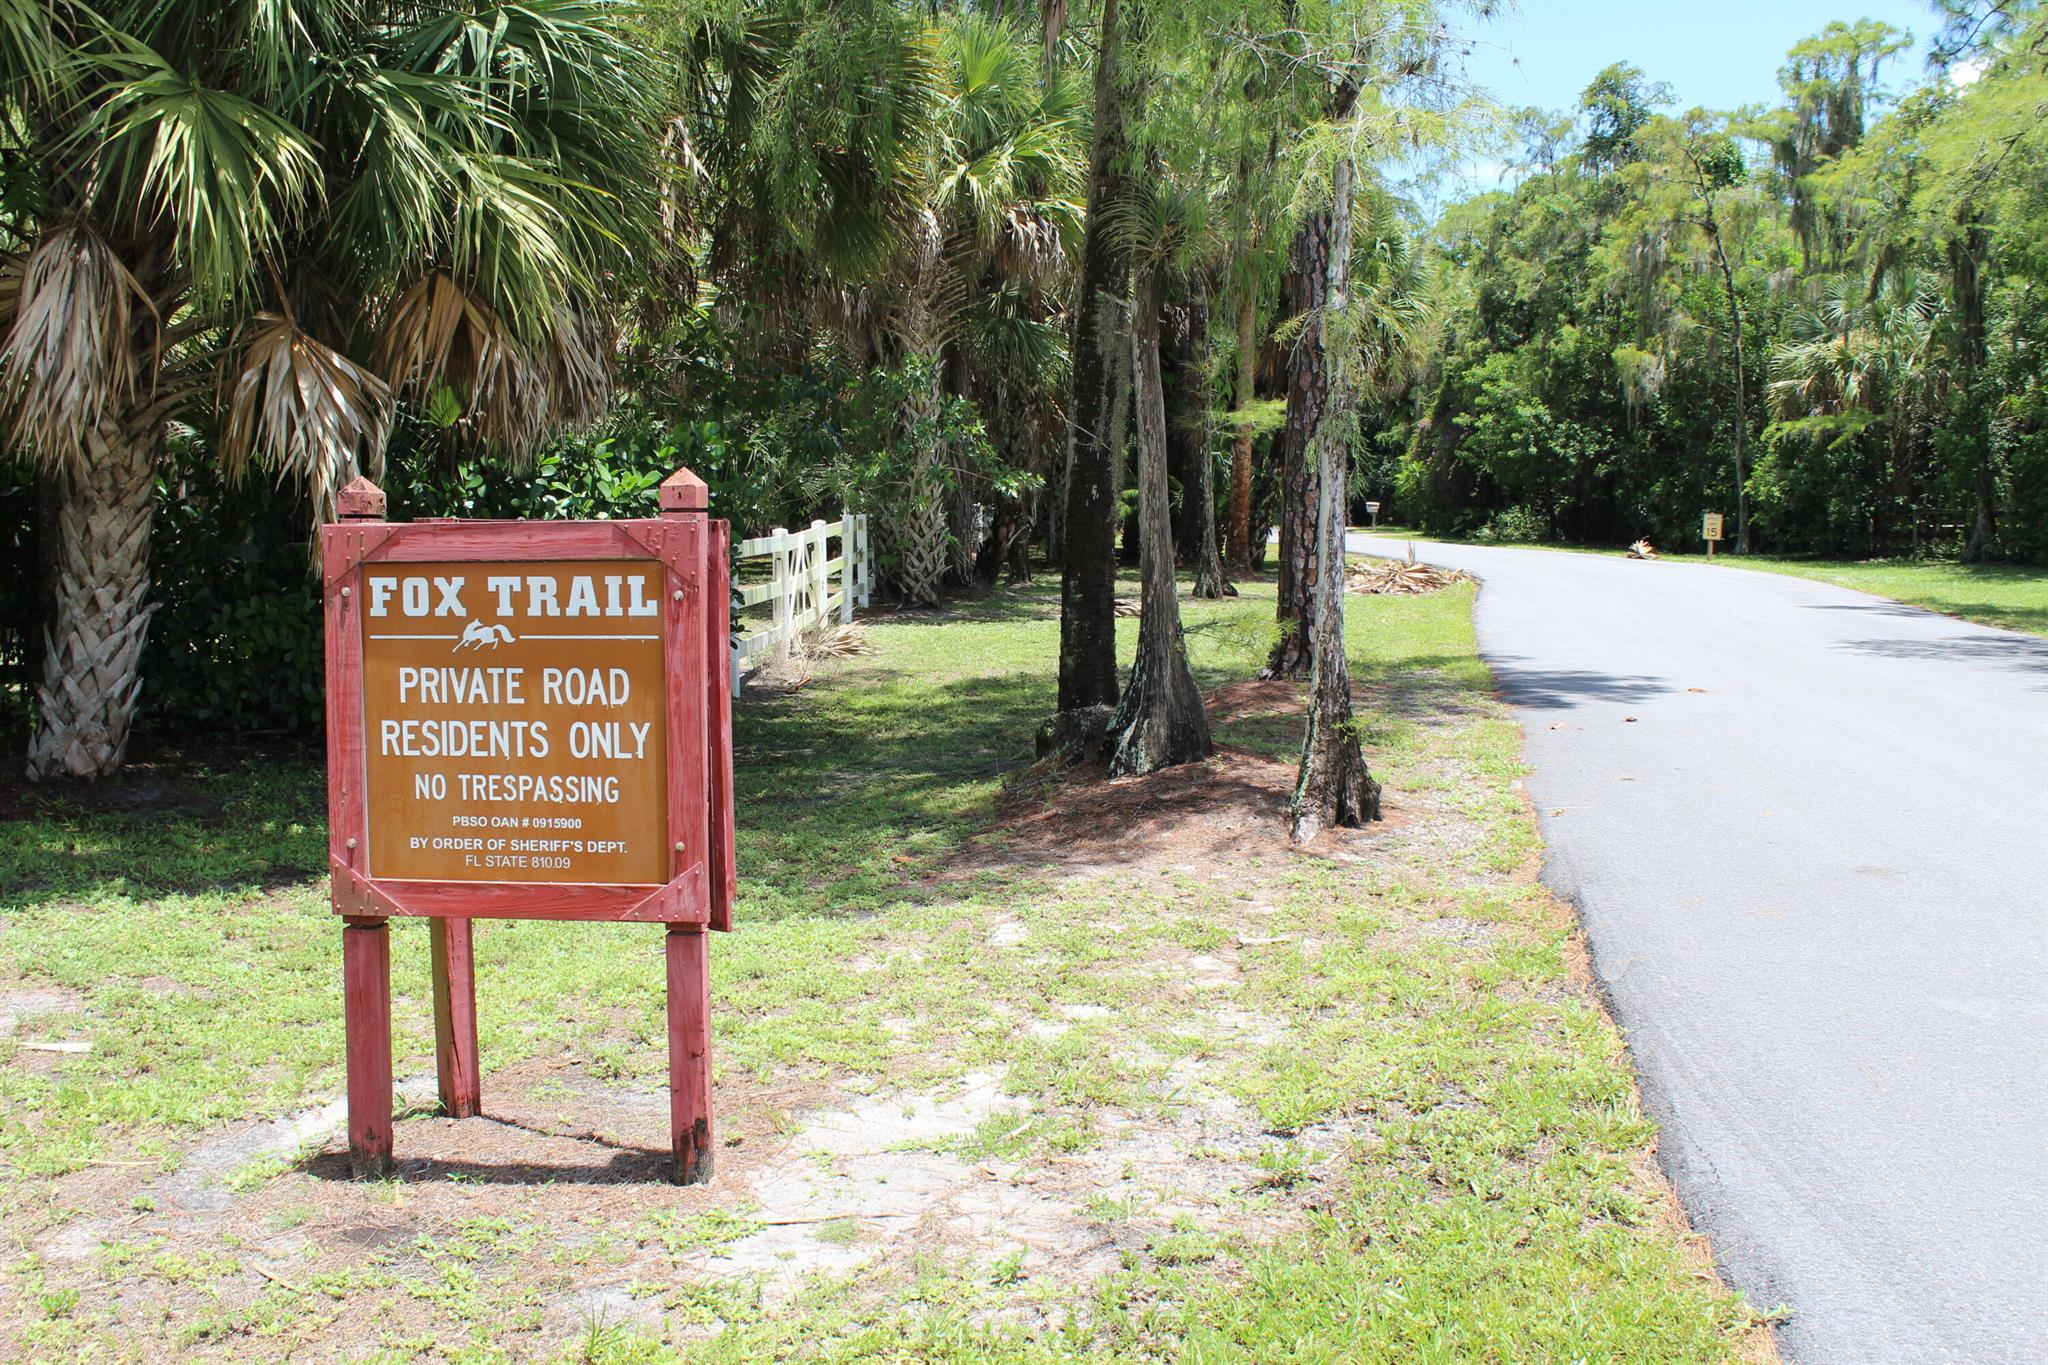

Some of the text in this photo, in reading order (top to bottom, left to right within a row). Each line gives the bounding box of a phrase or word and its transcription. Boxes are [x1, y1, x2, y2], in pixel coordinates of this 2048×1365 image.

[1707, 528, 1717, 537] 15
[369, 576, 659, 617] FOX TRAIL
[399, 667, 630, 705] PRIVATE ROAD
[381, 720, 651, 759] RESIDENTS ONLY
[415, 773, 619, 803] NO TRESPASSING
[452, 816, 582, 829] PBSO OAN # 0915900
[410, 837, 628, 854] BY ORDER OF SHERIFF'S DEPT.
[465, 854, 571, 869] FL STATE 810.09
